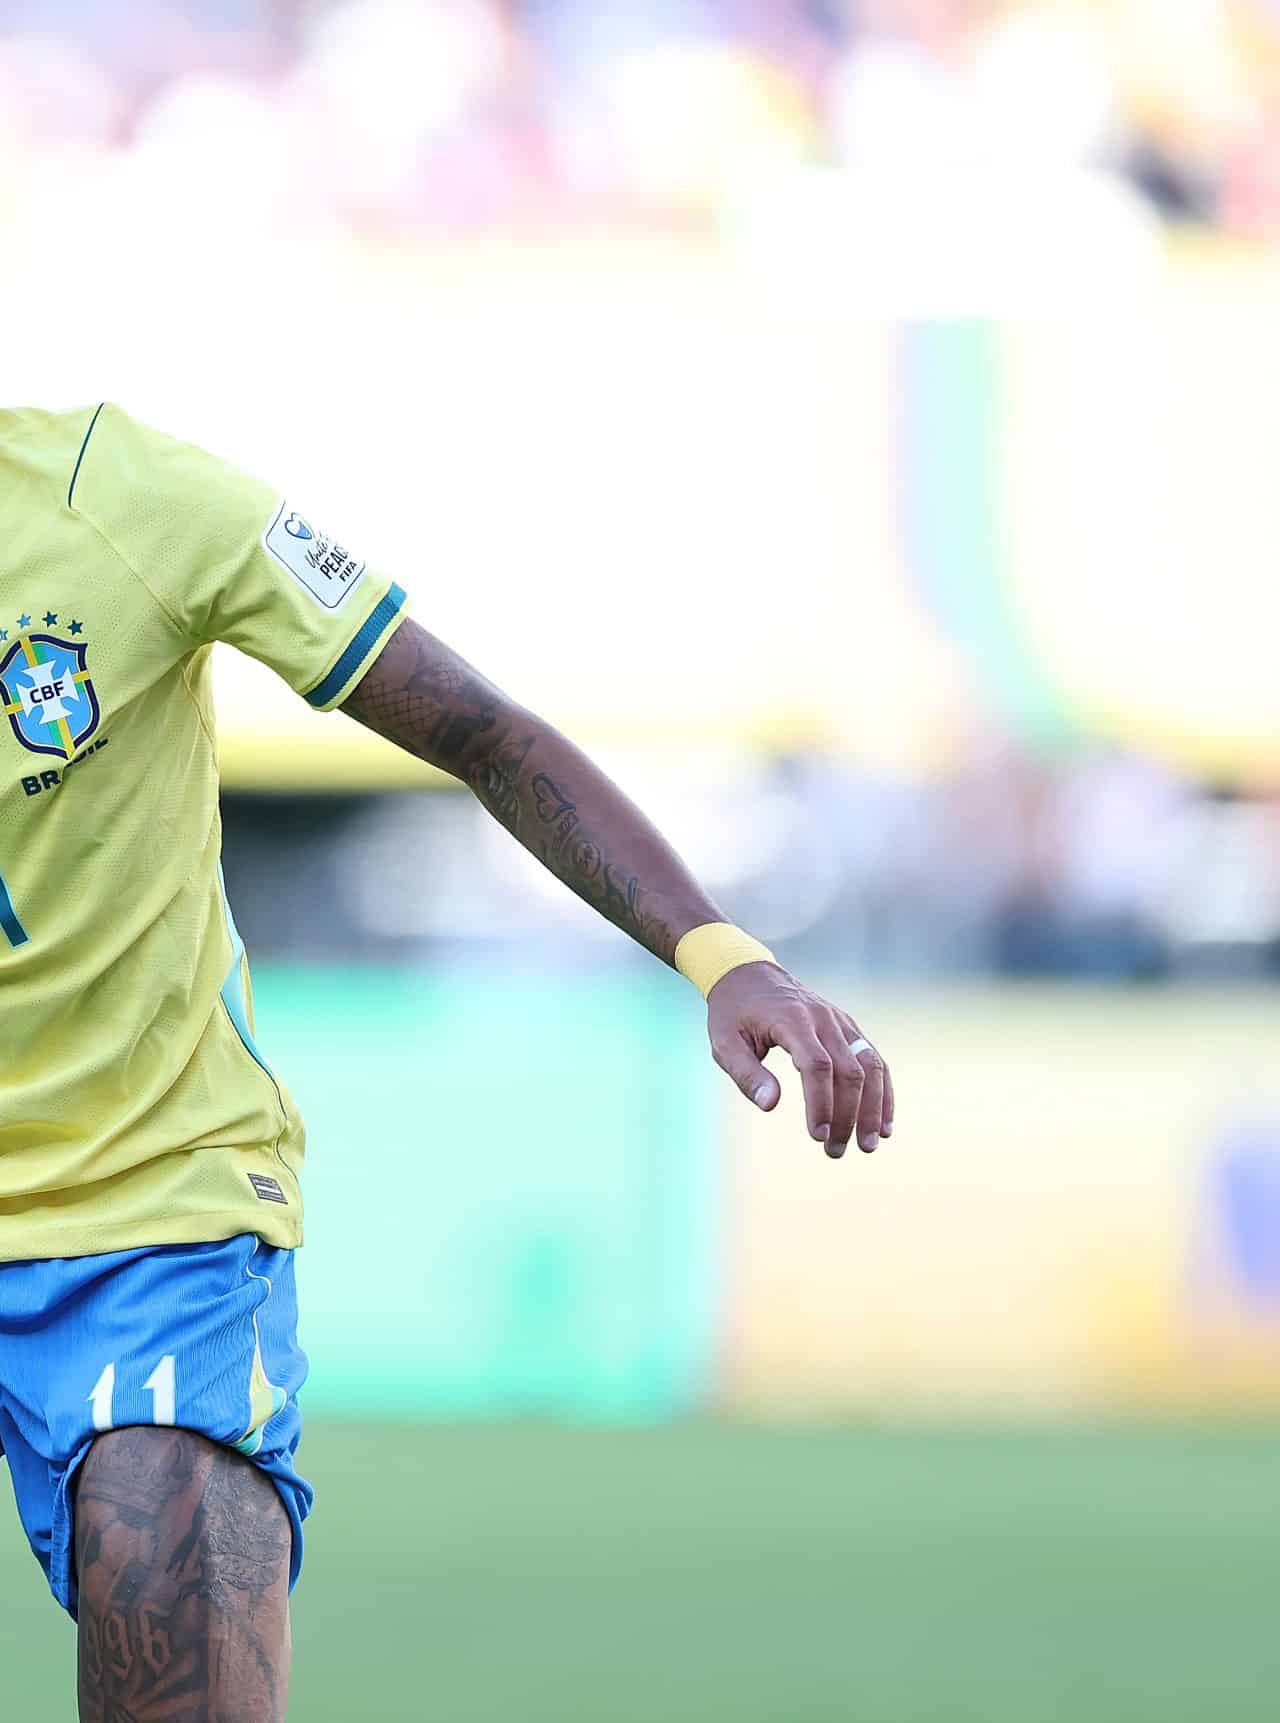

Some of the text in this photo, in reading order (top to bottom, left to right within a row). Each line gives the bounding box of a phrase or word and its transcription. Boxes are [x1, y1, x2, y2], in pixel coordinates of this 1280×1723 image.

[320, 544, 349, 580] PEAC
[339, 561, 357, 582] FIFA
[29, 682, 65, 704] CBF
[87, 1354, 177, 1431] 11
